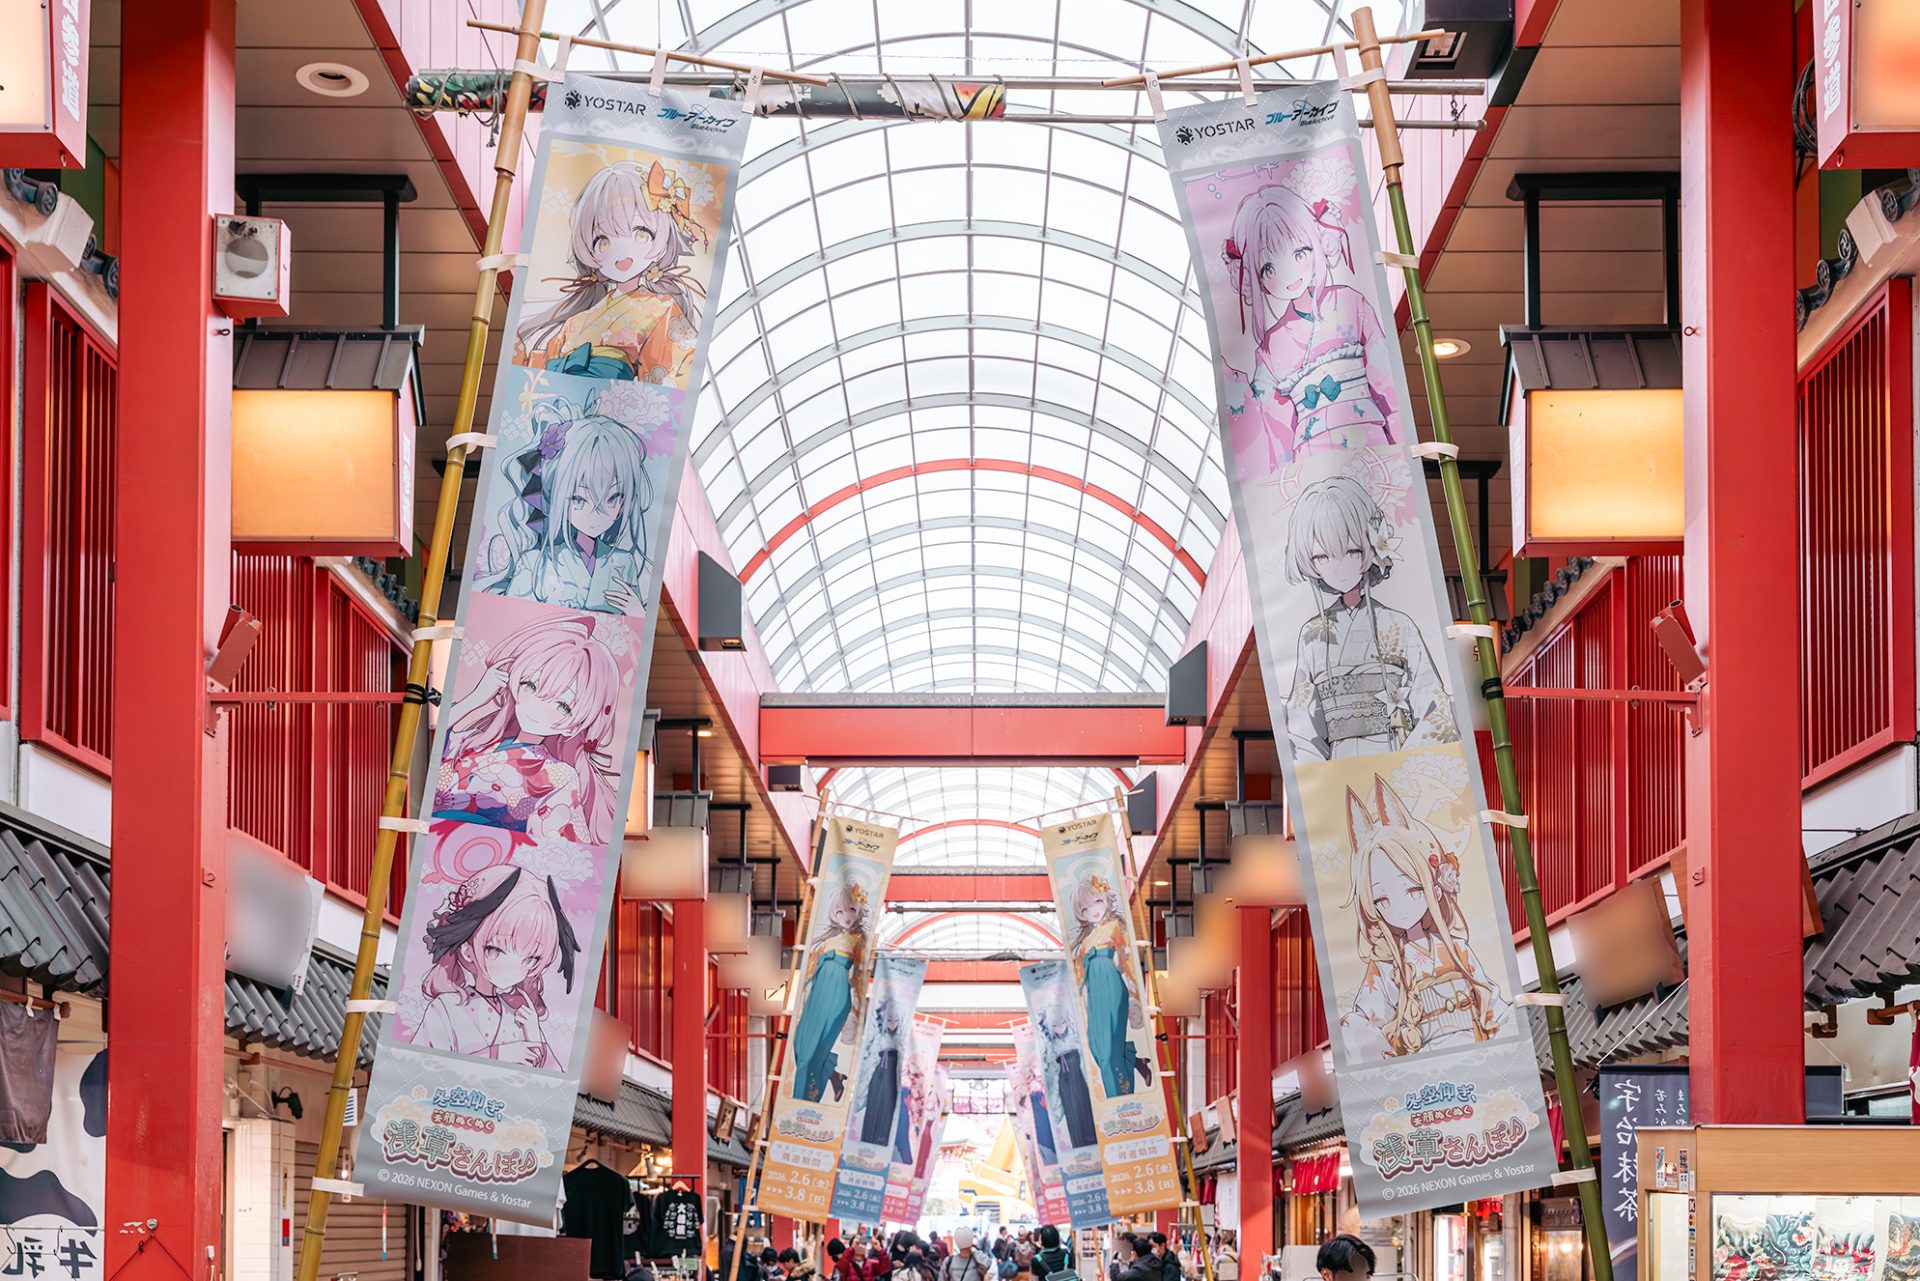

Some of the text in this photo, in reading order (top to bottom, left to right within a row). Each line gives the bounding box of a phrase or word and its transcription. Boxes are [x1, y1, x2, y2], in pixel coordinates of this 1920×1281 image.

[584, 96, 646, 117] YOSTAR
[1194, 118, 1256, 140] YOSTAR
[432, 1110, 494, 1133] 笑顔ぬくぬく
[1411, 1105, 1474, 1126] 笑顔ぬくぬく
[789, 1170, 811, 1186] 2.6
[1133, 1163, 1154, 1178] 2.6
[1396, 1183, 1420, 1198] 2026
[1421, 1176, 1456, 1193] NEXON
[1458, 1171, 1493, 1187] Games
[1494, 1169, 1503, 1179] &
[1504, 1163, 1536, 1177] Yostar
[391, 1171, 415, 1187] 2026
[416, 1175, 453, 1194] NEXON
[454, 1184, 489, 1201] Games
[490, 1192, 499, 1202] &
[500, 1193, 532, 1209] Yostar
[785, 1185, 806, 1201] 3.8
[1135, 1179, 1156, 1195] 3.8
